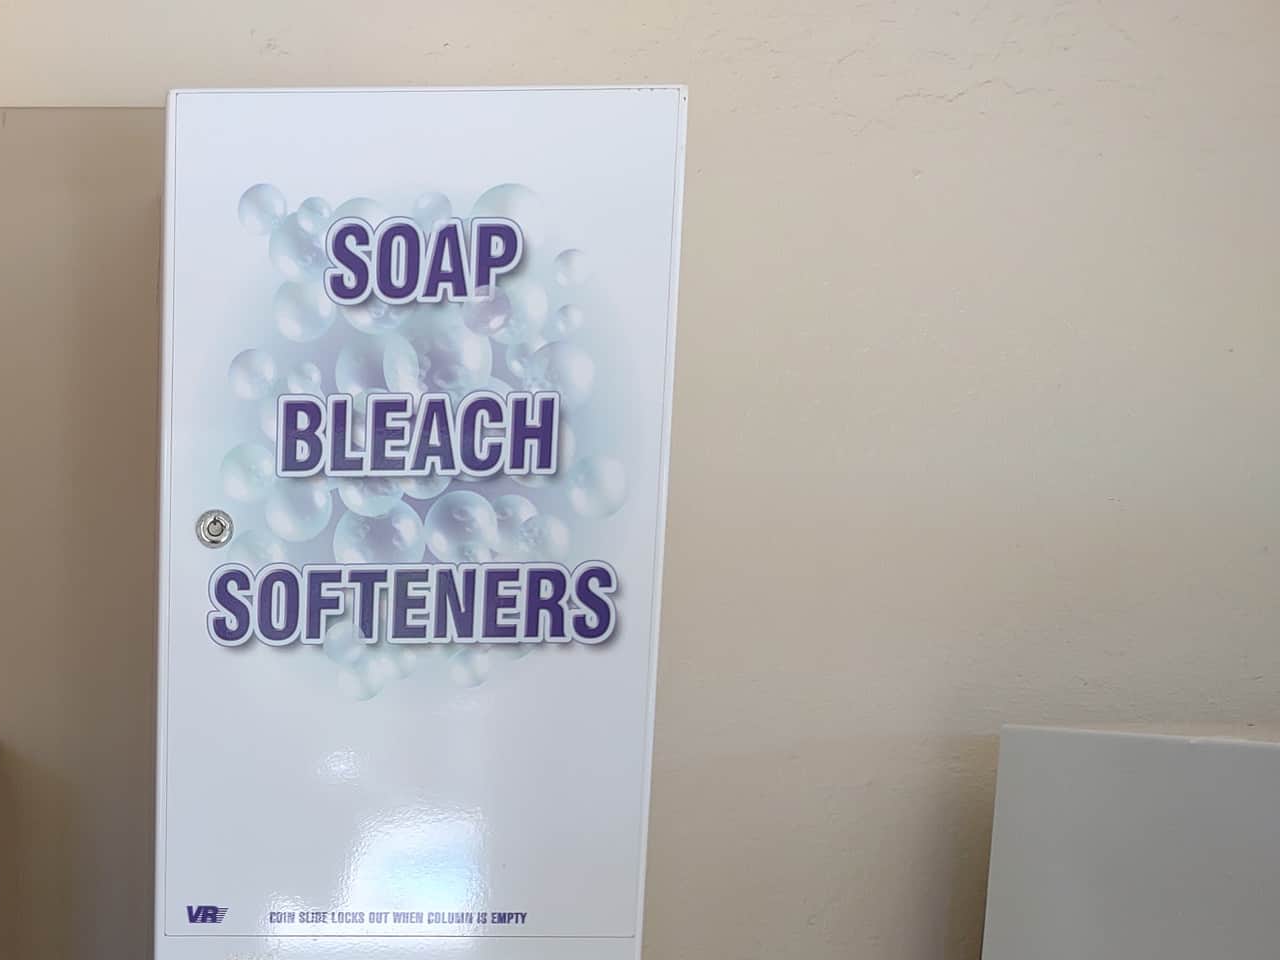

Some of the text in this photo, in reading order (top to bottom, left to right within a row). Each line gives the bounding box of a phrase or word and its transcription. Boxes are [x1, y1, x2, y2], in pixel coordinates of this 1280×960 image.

[324, 218, 523, 304] SOAP
[279, 393, 559, 476] BLEACH
[210, 563, 618, 646] SOFTENERS
[269, 911, 528, 924] COIN SLIDE LOCKS OUT WHEN COLUMN IS EMPTY
